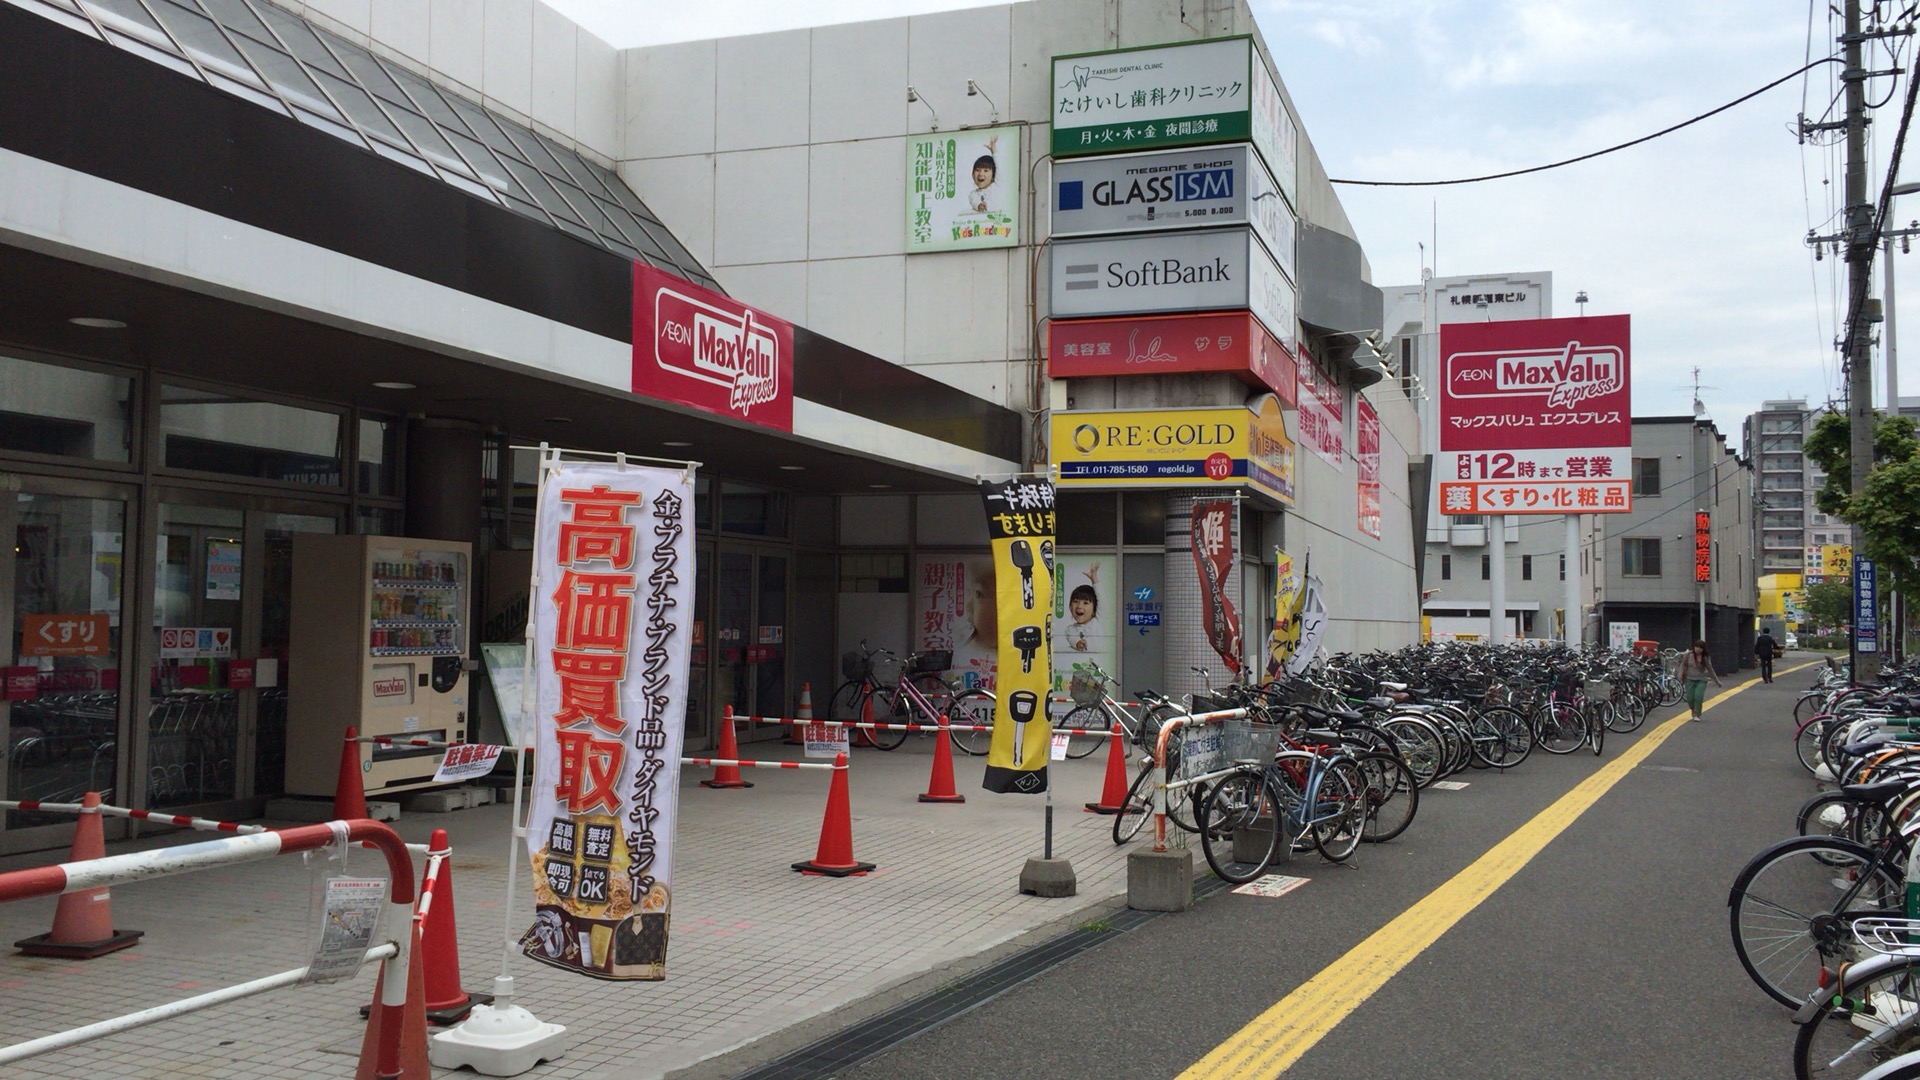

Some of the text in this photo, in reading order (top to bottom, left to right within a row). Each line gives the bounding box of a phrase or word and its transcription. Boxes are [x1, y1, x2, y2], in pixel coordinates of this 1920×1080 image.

[1092, 62, 1163, 75] TAKEISHI DENTAL CLINIC
[1059, 81, 1242, 114] たけいし歯科クリニック
[1080, 118, 1219, 144] 月・火・木・金 夜間診療
[1126, 160, 1233, 175] MEGANE SHOP
[915, 141, 933, 244] 知能向上教室
[1092, 170, 1233, 206] GLASSISM
[1107, 257, 1231, 288] SoftBank
[699, 314, 770, 379] MaxValu
[1063, 342, 1111, 357] 美容室
[1503, 343, 1610, 385] MaxValu
[731, 372, 773, 415] Express
[1550, 377, 1614, 407] Express
[1450, 411, 1621, 428] マックスバリュ エクスプレス
[1158, 464, 1195, 476] regold.jp
[1459, 455, 1470, 478] よる
[1475, 453, 1612, 479] 12時まで営業
[1446, 486, 1472, 511] 薬
[1482, 486, 1625, 507] くすり・化粧品
[1696, 513, 1710, 582] 動物病院
[39, 620, 95, 643] くすり
[551, 485, 643, 815] 高価買取
[627, 489, 683, 904] 金・プラチナ・ブランド品・ダイヤモンド
[443, 744, 501, 768] 駐輪禁止
[553, 822, 574, 838] 高額
[587, 827, 612, 843] 無料
[552, 836, 573, 852] 買取
[585, 842, 610, 857] 査定
[547, 862, 572, 879] 即現
[581, 880, 605, 899] OK
